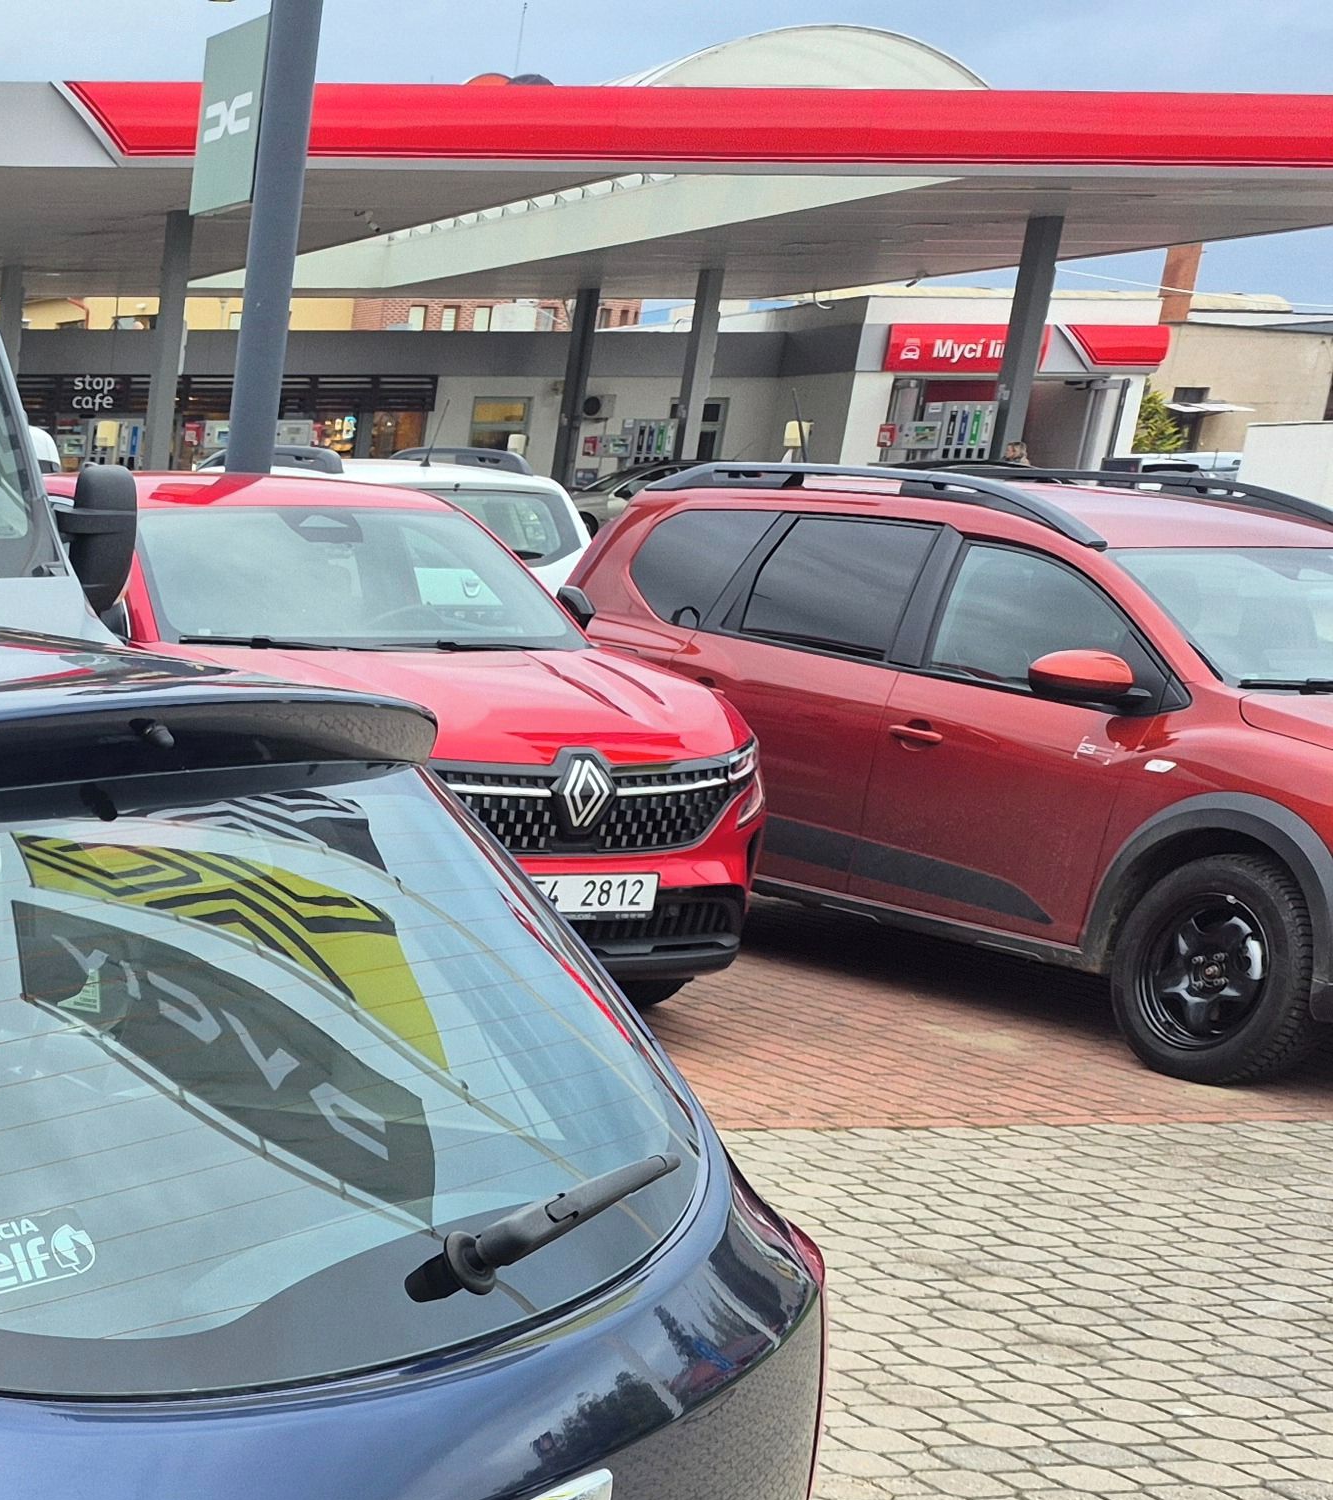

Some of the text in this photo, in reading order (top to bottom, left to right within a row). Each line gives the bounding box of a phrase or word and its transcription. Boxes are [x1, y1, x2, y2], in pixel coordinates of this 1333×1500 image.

[932, 338, 984, 364] Mycí
[73, 374, 115, 395] stop
[72, 393, 114, 412] cafe
[580, 879, 645, 907] 2812
